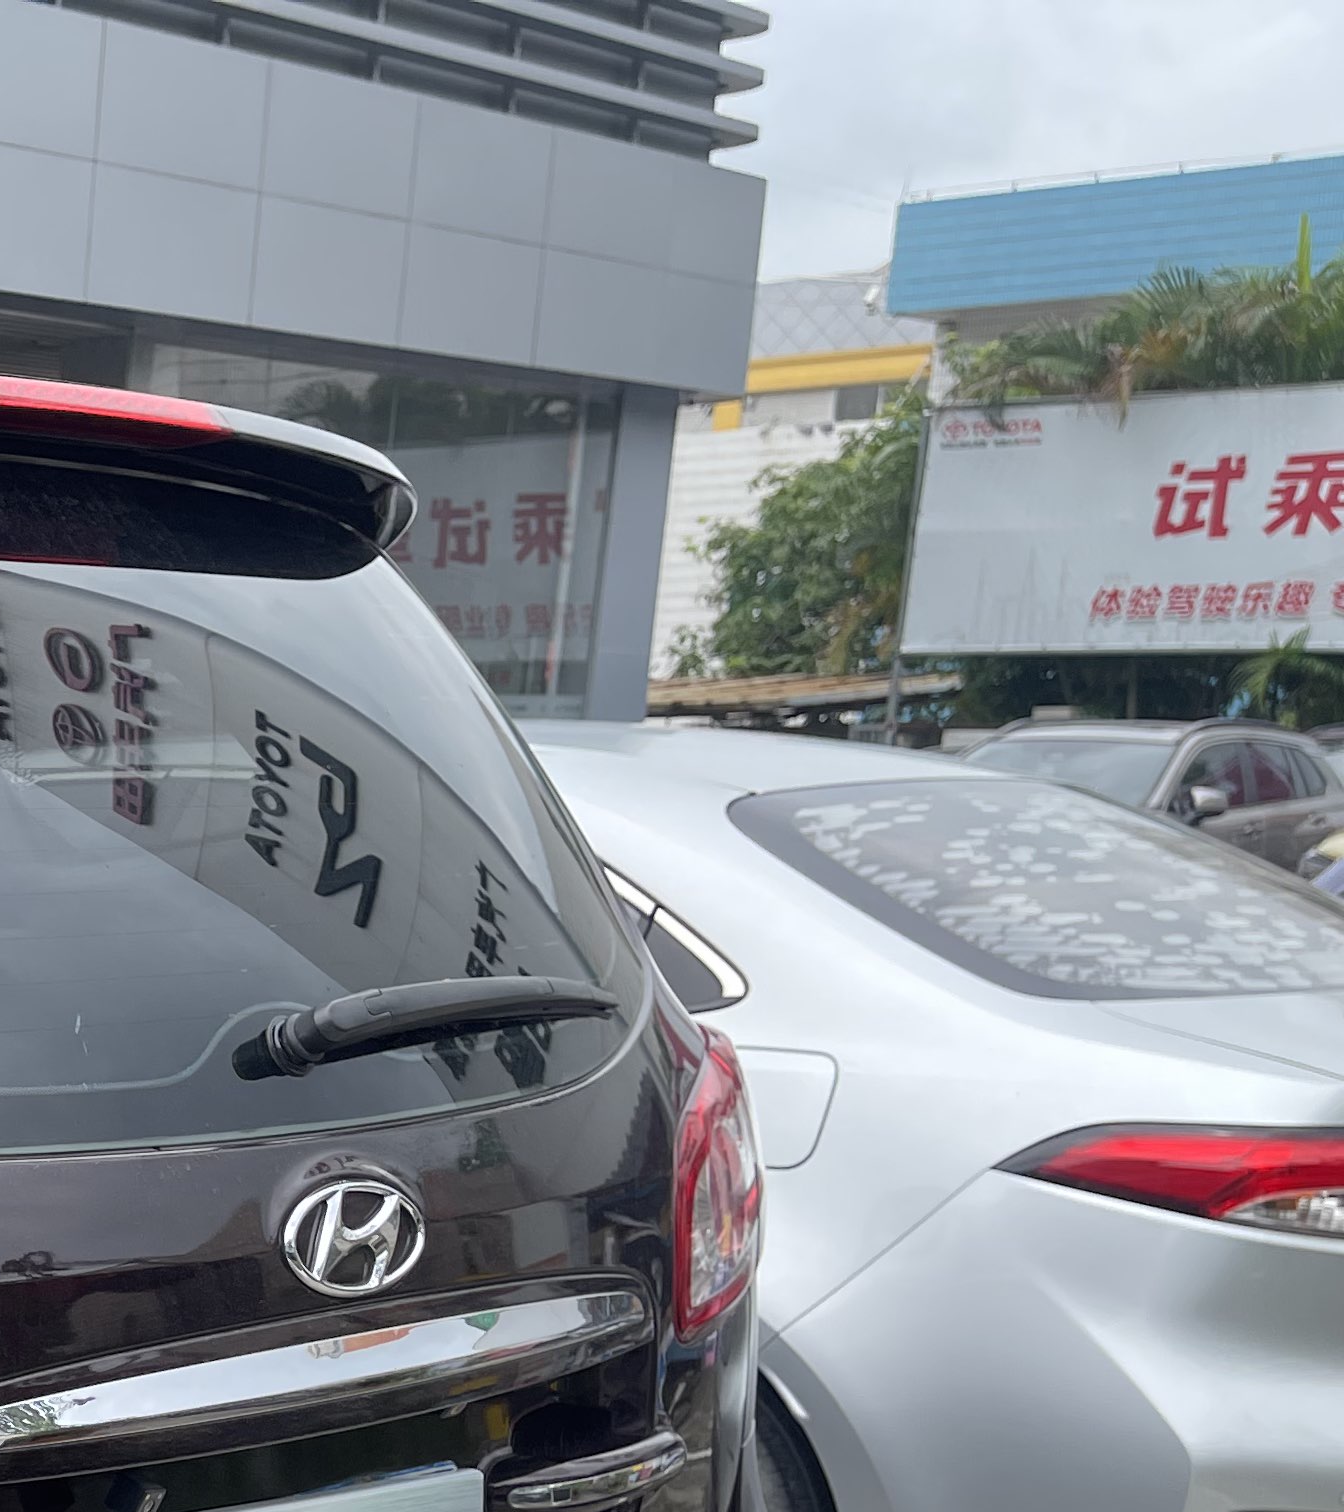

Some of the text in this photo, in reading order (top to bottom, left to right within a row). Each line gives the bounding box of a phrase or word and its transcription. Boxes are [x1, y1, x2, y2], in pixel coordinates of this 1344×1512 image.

[1087, 578, 1316, 624] 体验驾驶乐趣
